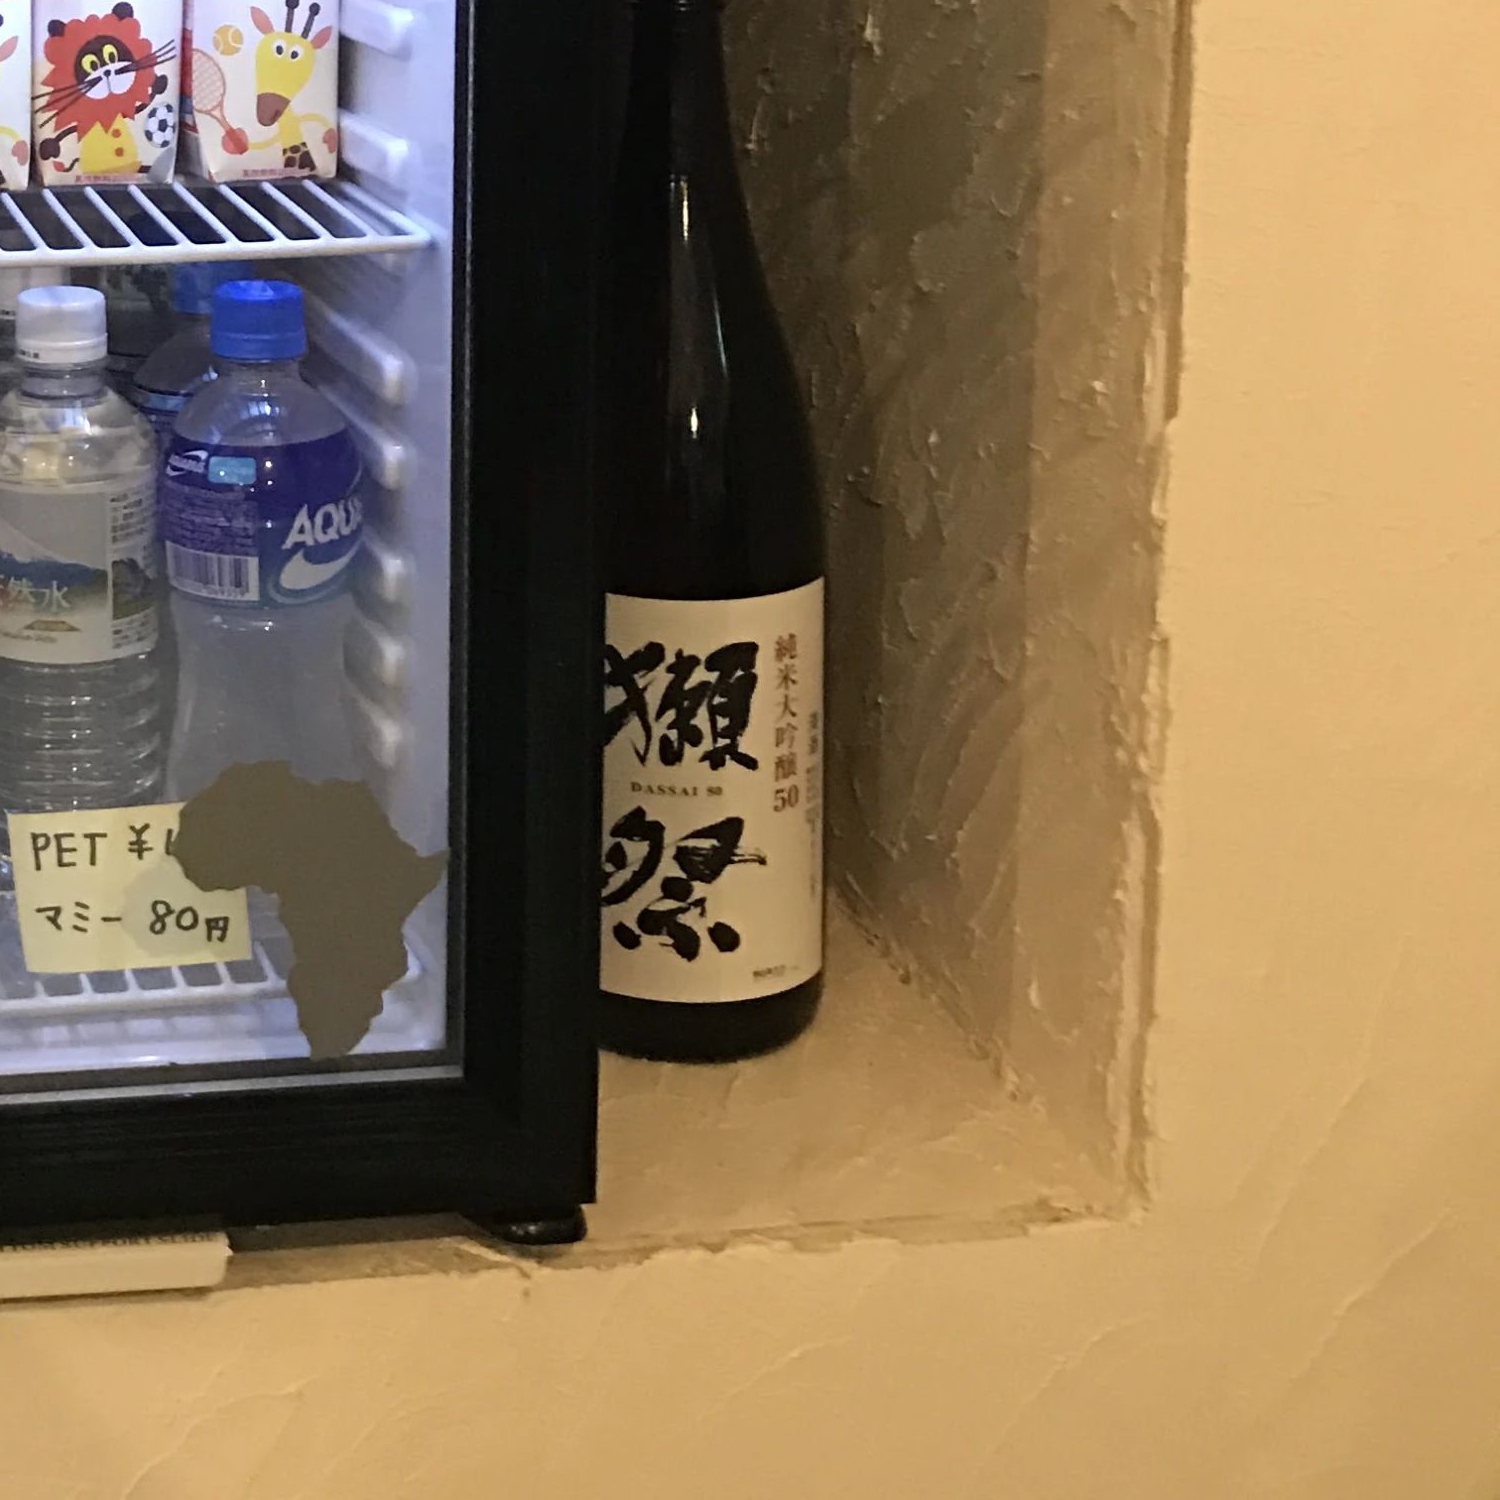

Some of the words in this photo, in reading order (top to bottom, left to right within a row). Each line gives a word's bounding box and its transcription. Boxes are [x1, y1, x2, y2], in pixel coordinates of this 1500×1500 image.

[630, 781, 699, 798] DASSAI
[31, 831, 108, 871] PET
[34, 901, 122, 933] マミー
